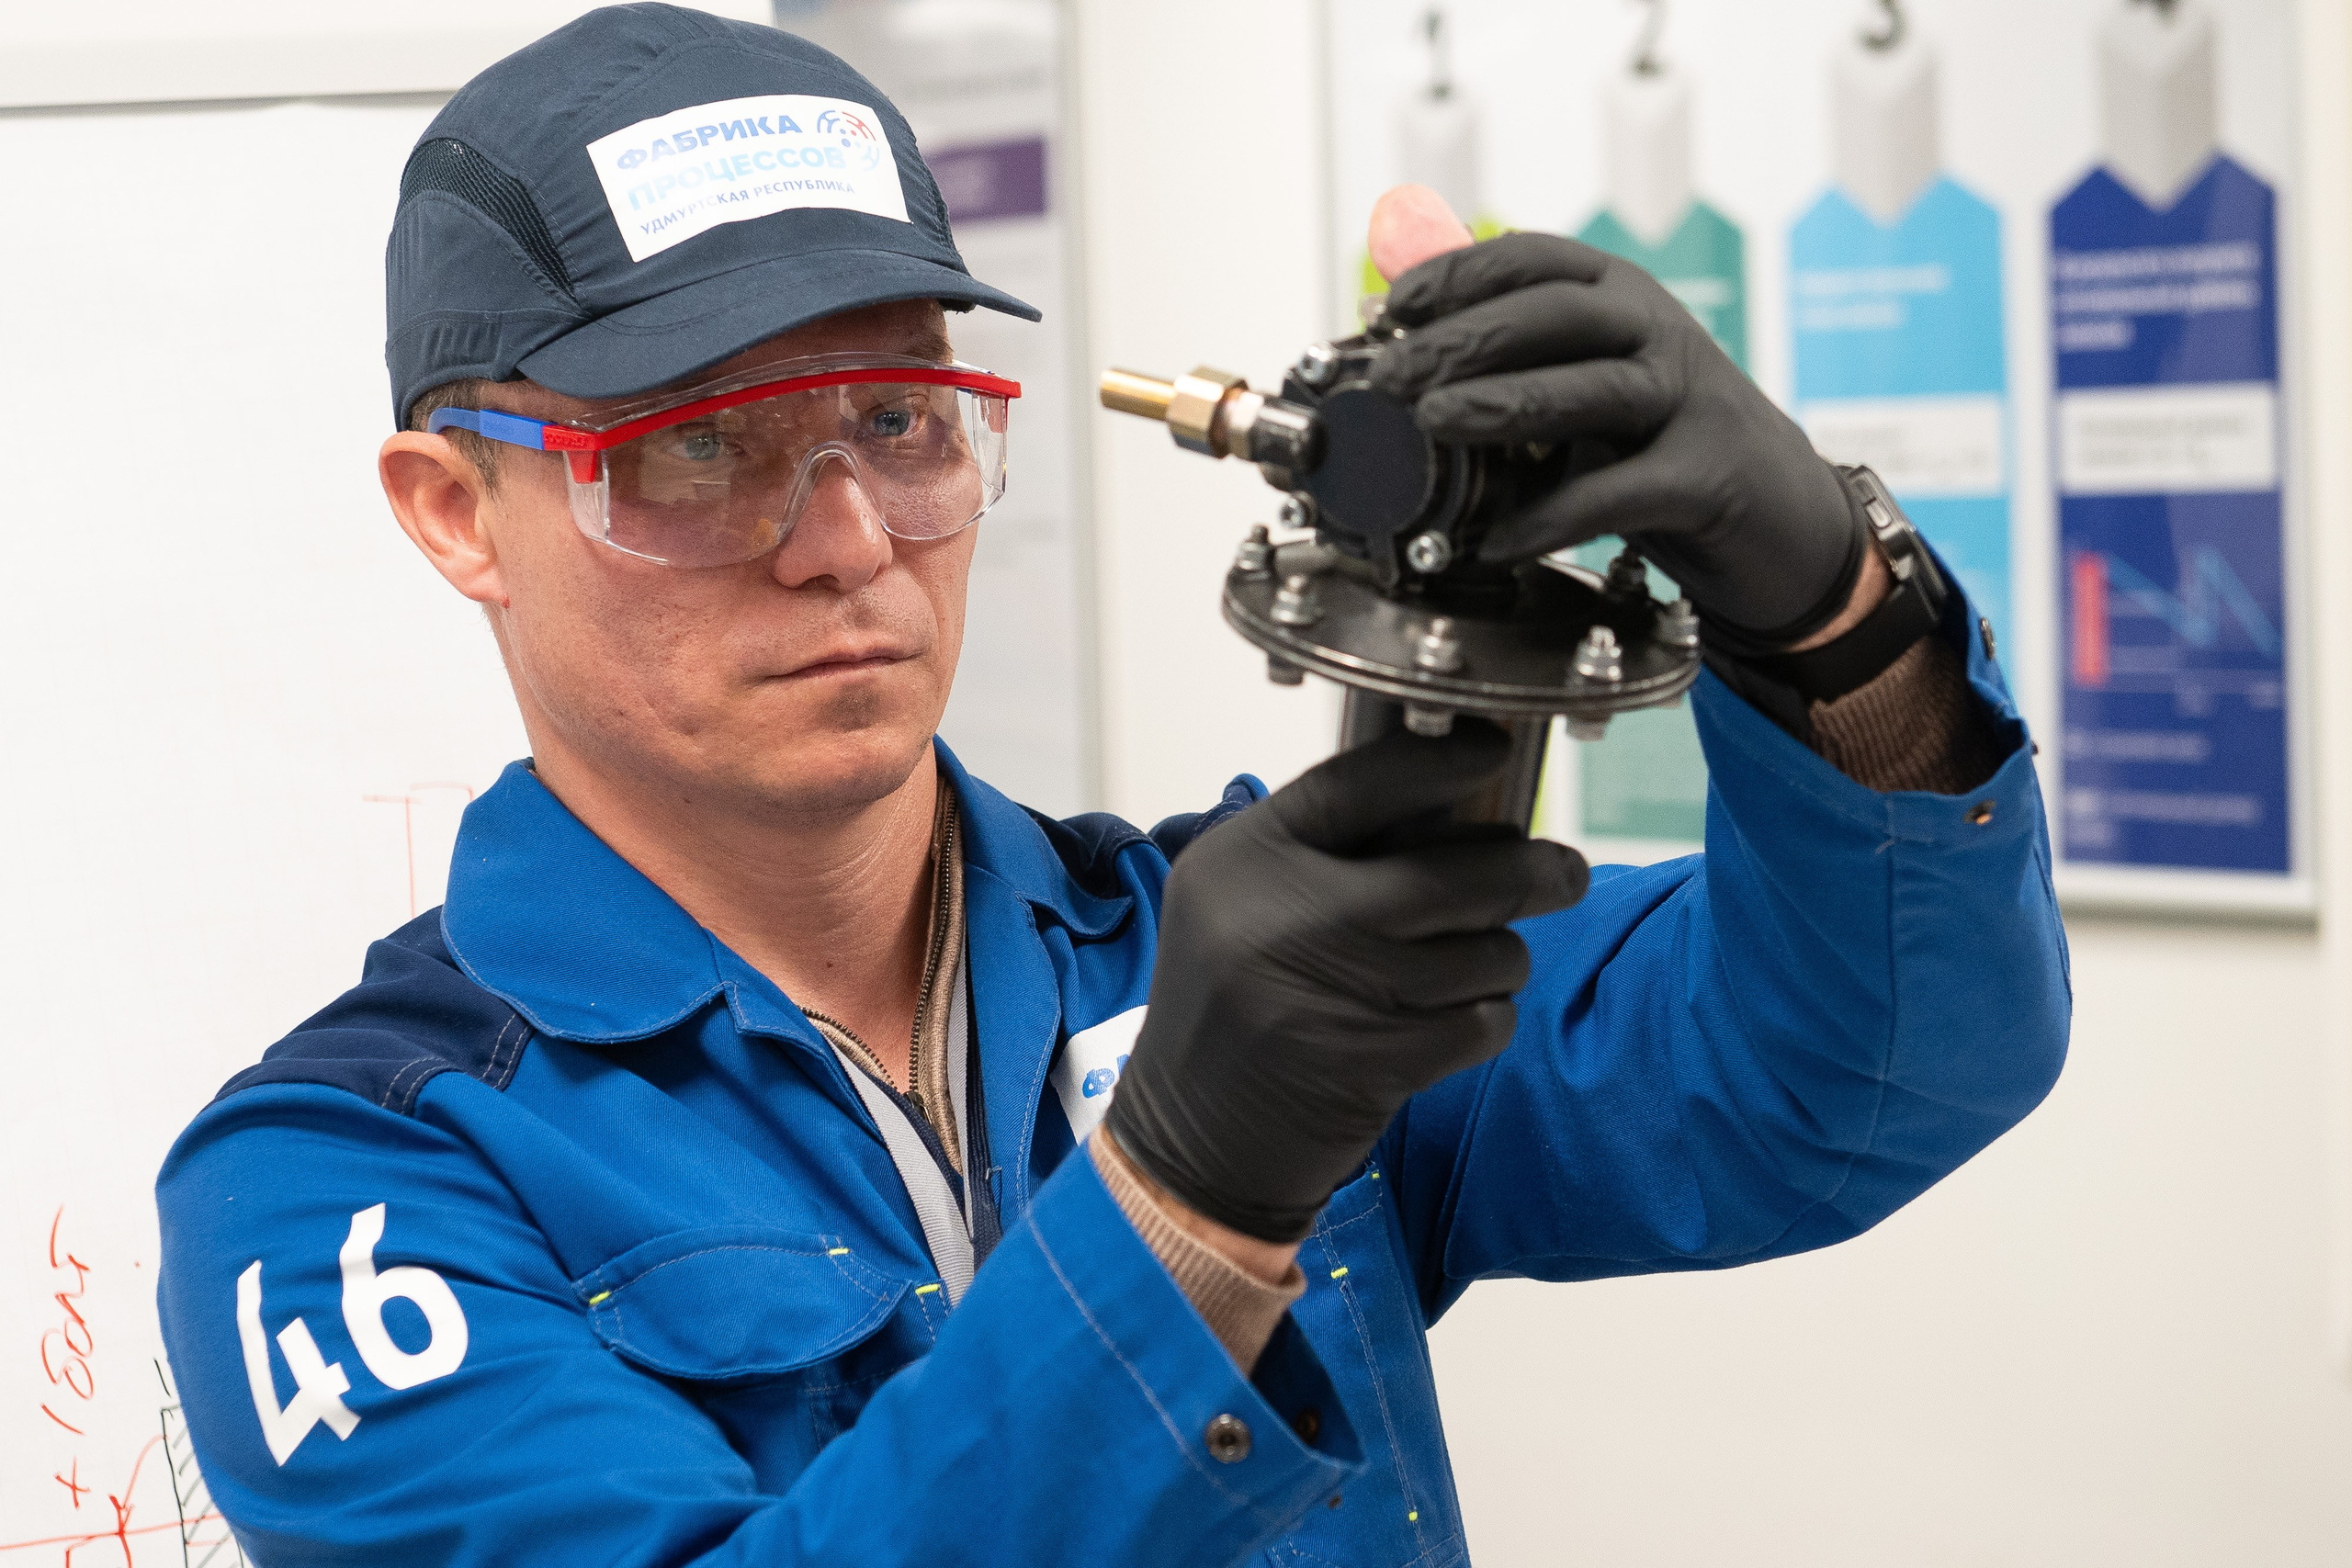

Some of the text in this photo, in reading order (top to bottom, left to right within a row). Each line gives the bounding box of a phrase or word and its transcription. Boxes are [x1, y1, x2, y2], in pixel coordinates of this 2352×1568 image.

[616, 114, 803, 171] ФАБРИКА
[627, 146, 847, 211] ПРОЦЕССОВ
[639, 178, 855, 236] УДМУРТСКАЯ РЕСПУБЛИКА
[235, 1201, 469, 1468] 46
